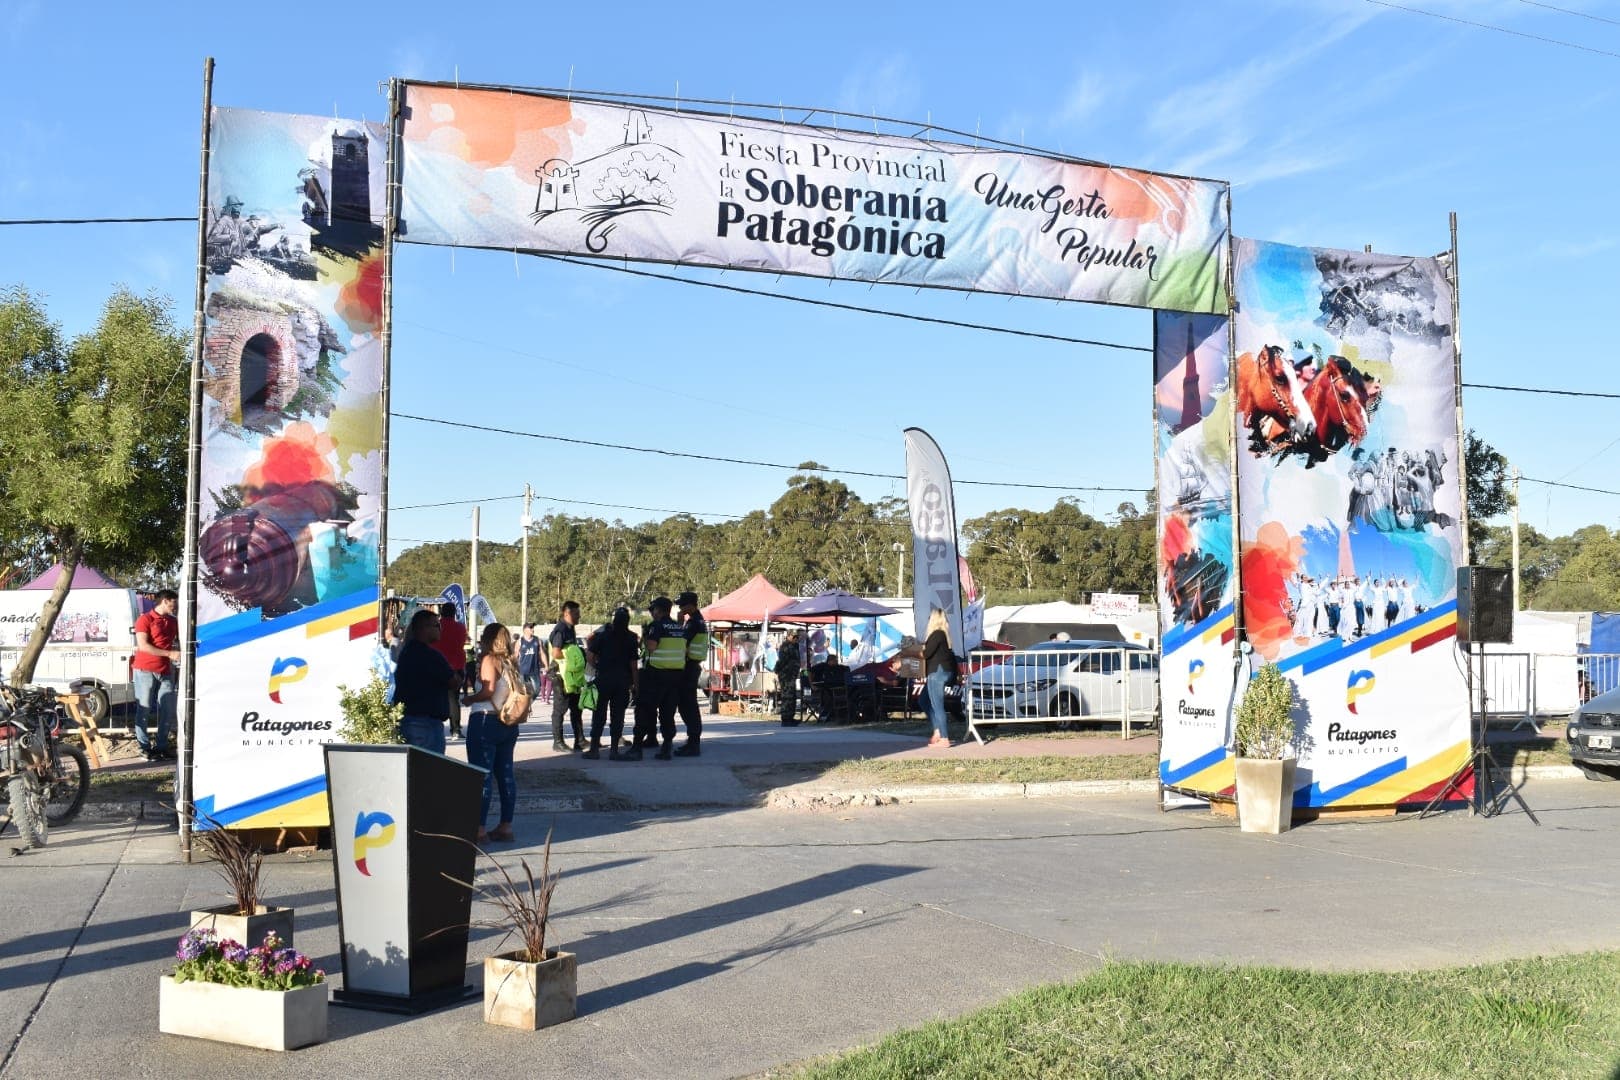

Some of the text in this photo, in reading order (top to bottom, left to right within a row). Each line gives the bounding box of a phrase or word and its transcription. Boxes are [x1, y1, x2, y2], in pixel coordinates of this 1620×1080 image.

[719, 131, 946, 183] Fiesta Provincial
[719, 162, 741, 179] de
[720, 180, 734, 198] la
[744, 167, 948, 223] Soberanía
[974, 172, 1113, 233] Una Gesta
[717, 201, 946, 260] Patagónica
[1056, 227, 1158, 281] Popular
[1179, 699, 1215, 719] Patagones
[241, 711, 332, 736] Patagones
[1328, 722, 1397, 745] Patagones
[1328, 746, 1399, 755] MUNICIPIO
